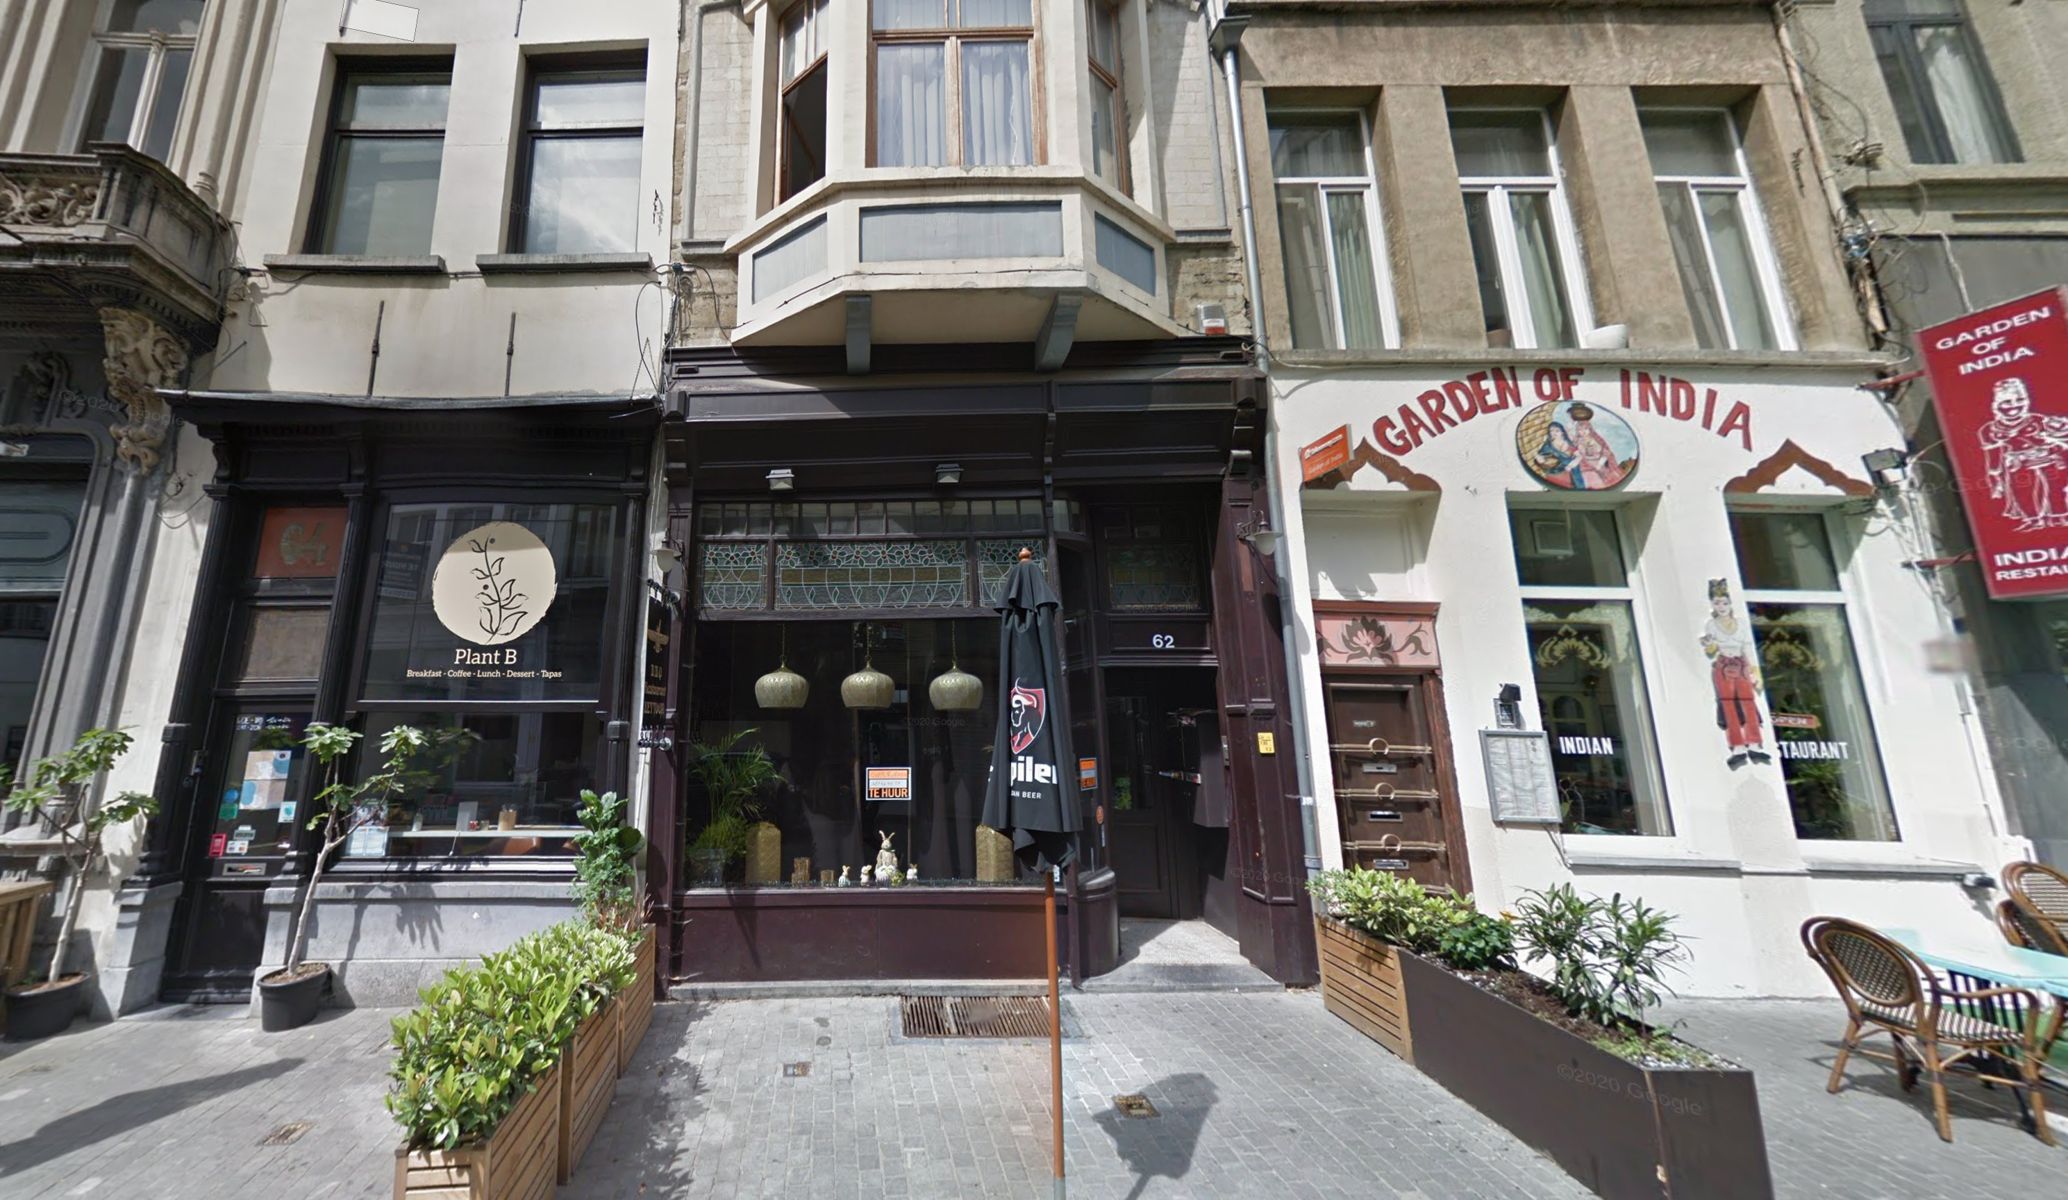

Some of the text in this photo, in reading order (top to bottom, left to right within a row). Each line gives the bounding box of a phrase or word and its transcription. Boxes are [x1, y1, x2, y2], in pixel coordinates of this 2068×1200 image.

[1936, 306, 2050, 349] GARDEN
[1971, 336, 2006, 354] OF
[1958, 346, 2035, 375] INDIA
[1373, 366, 1753, 456] GARDEN OF INDIA
[1152, 633, 1175, 649] 62
[454, 648, 517, 665] Plant B
[406, 669, 562, 679] Breakfast Coffee Lunch Dessert Tapas
[1559, 736, 1614, 755] INDIAN
[869, 788, 908, 798] TE HUUR
[1022, 791, 1042, 799] BEER
